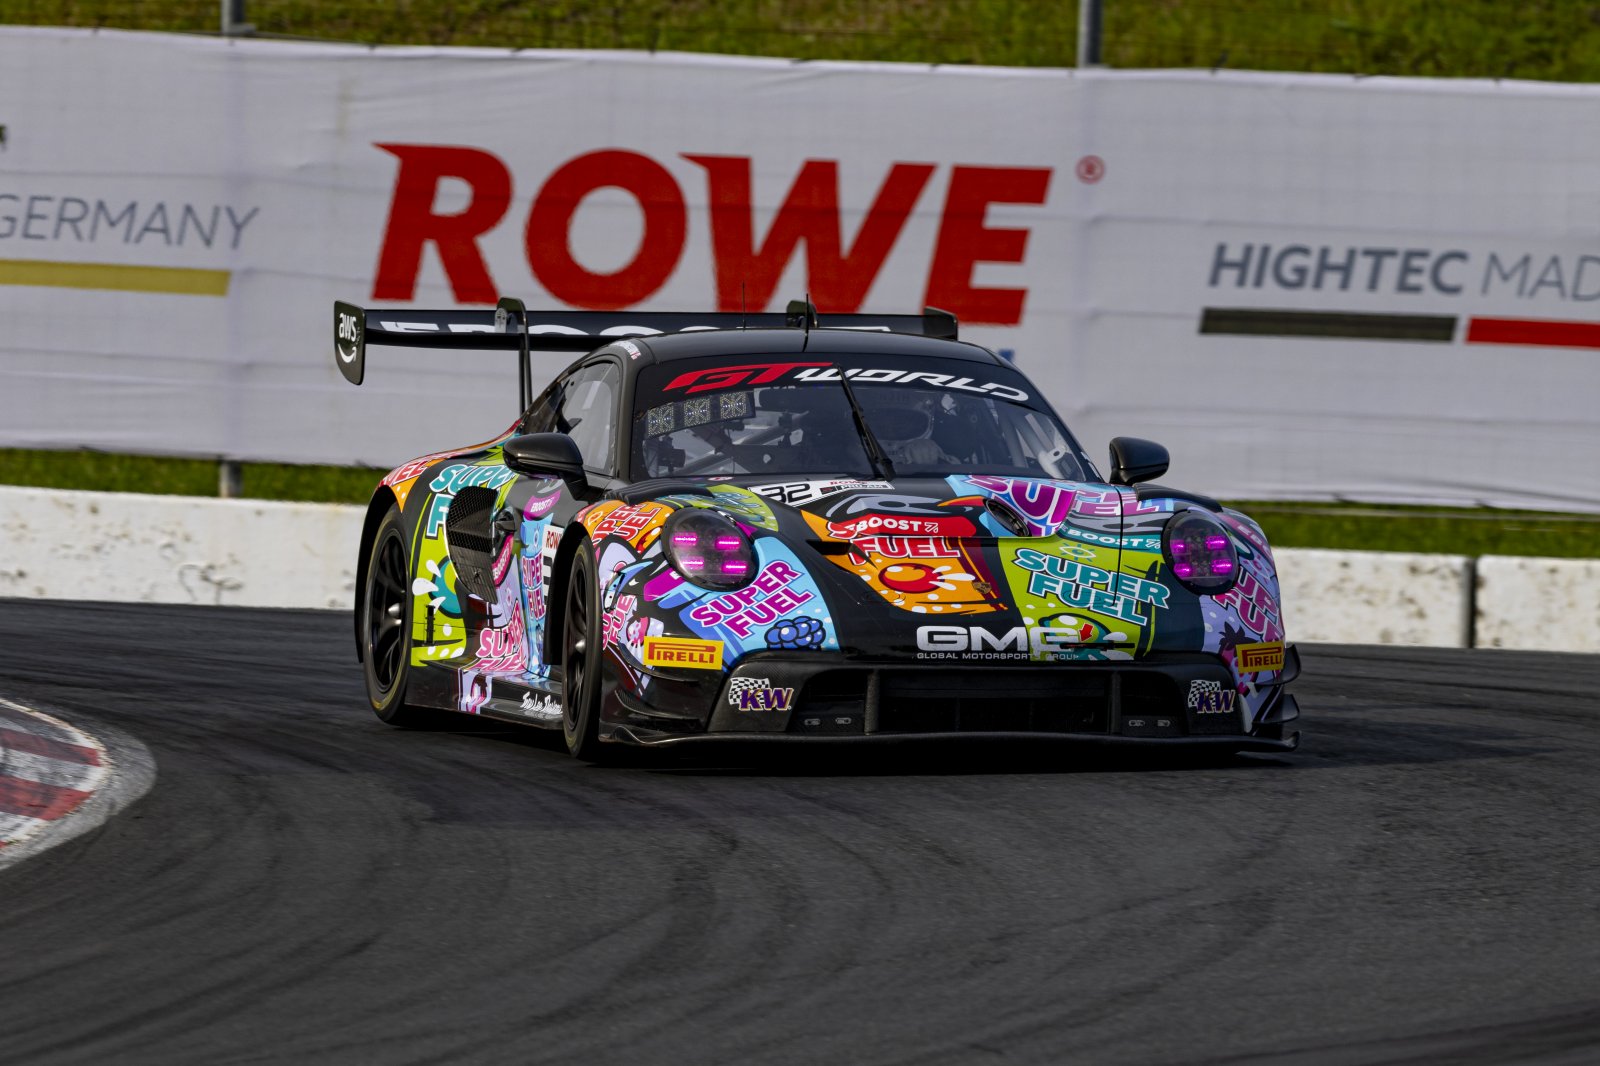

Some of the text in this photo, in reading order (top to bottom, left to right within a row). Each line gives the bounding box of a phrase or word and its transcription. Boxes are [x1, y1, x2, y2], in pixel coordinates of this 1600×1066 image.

[0, 193, 260, 249] GERMANY
[371, 142, 1053, 326] ROWE
[1207, 243, 1469, 295] HIGHTEC
[339, 312, 357, 342] aws
[662, 361, 1029, 402] GT WORLD
[758, 483, 813, 503] 32
[849, 535, 961, 565] FUEL
[690, 560, 803, 628] SUPER
[1014, 548, 1169, 610] SUPER
[1029, 571, 1148, 627] FUEL
[721, 586, 815, 639] FUEL
[648, 642, 716, 664] PIRELLI
[917, 652, 959, 661] GLOBAL
[738, 687, 794, 711] KW
[1197, 690, 1236, 713] KW
